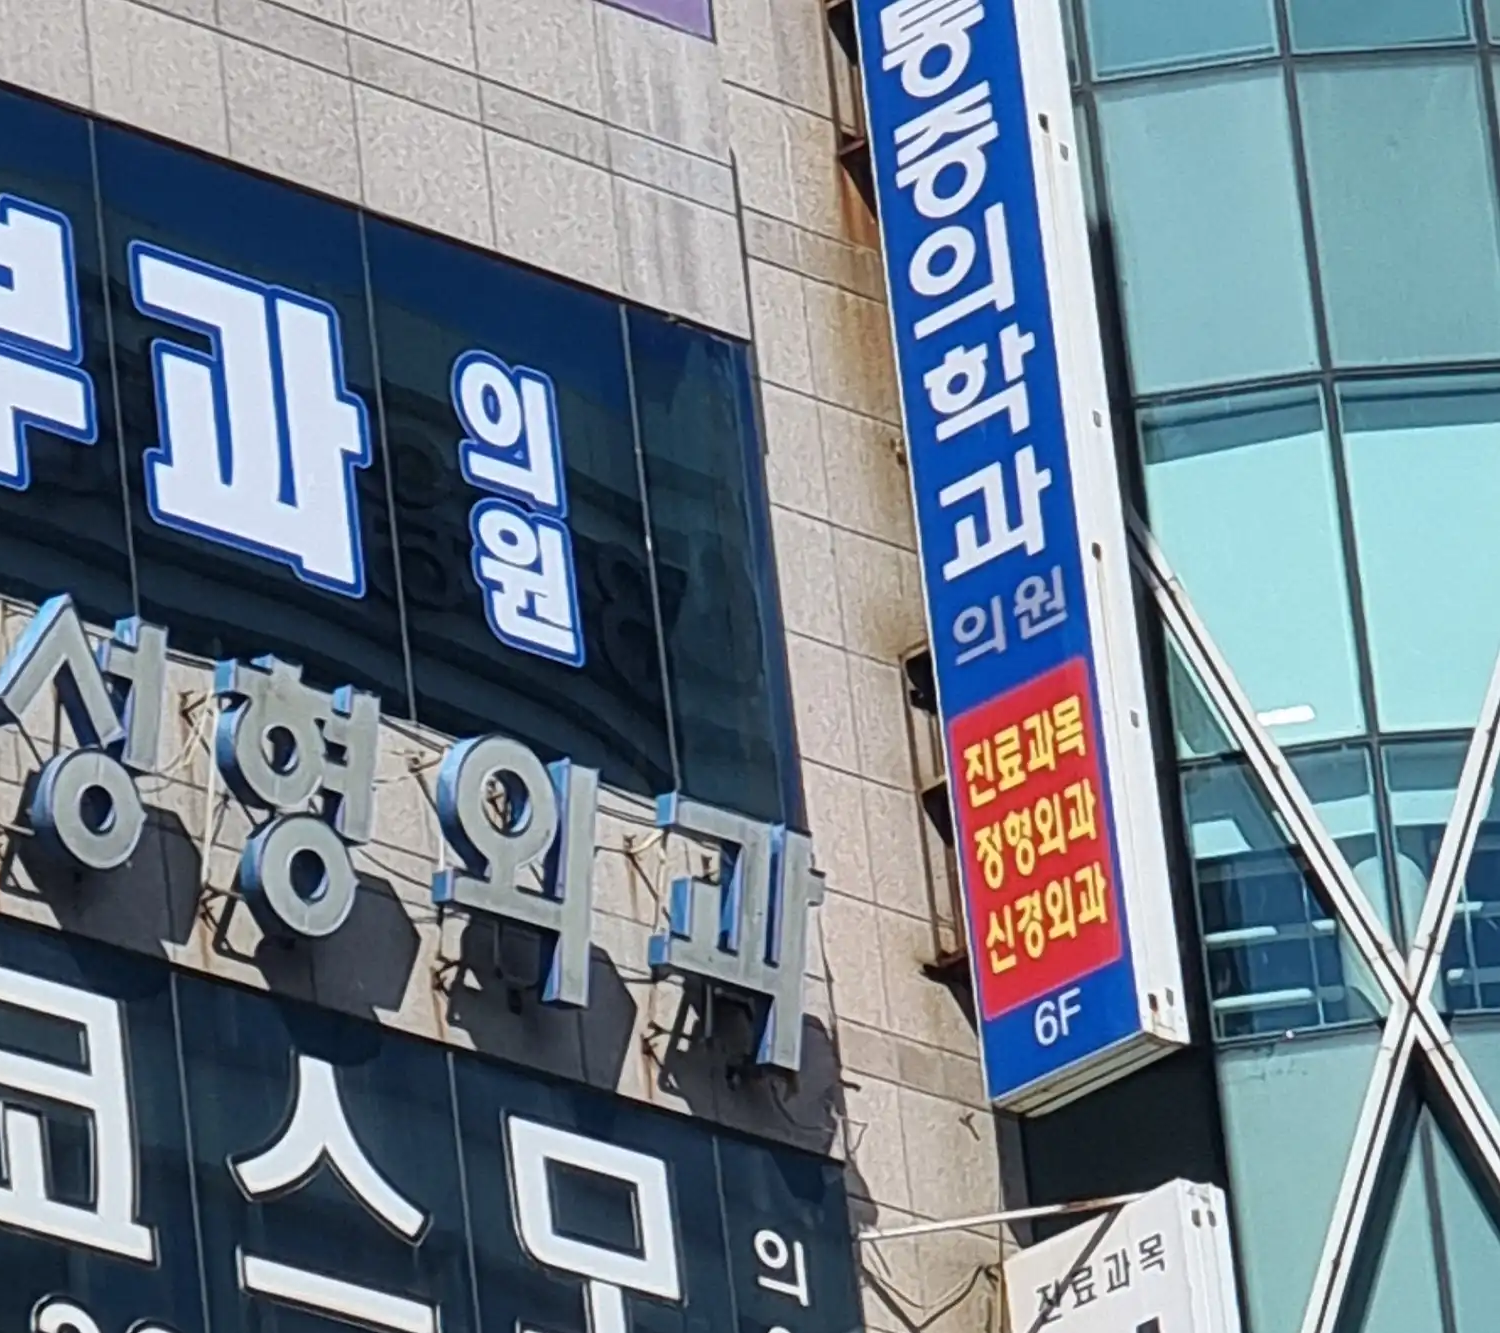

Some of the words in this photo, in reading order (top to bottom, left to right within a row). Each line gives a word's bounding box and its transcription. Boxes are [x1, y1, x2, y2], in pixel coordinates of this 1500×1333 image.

[452, 350, 585, 667] 의원
[952, 565, 1068, 666] 의원
[962, 694, 1088, 809] 진료과목
[973, 778, 1098, 891] 정형외과
[984, 860, 1108, 976] 신경외과
[1033, 988, 1082, 1047] 6F
[1036, 1233, 1165, 1326] 진료과목
